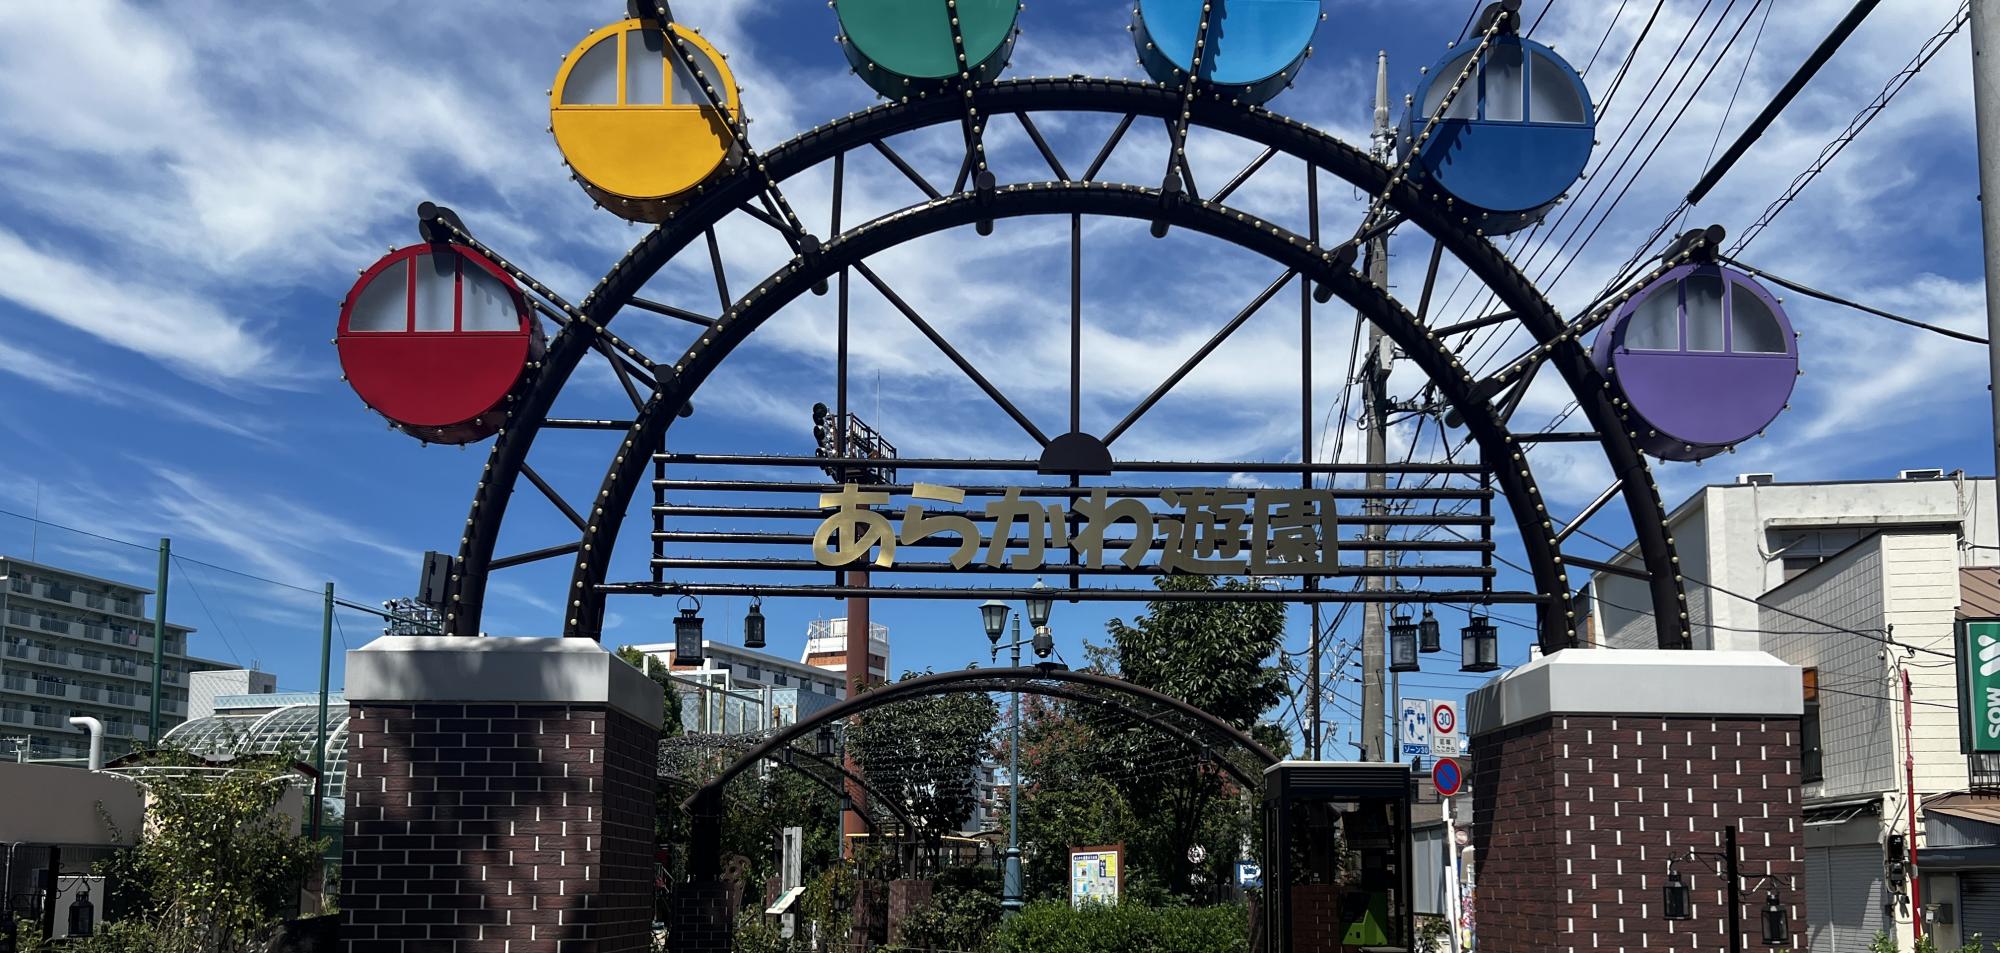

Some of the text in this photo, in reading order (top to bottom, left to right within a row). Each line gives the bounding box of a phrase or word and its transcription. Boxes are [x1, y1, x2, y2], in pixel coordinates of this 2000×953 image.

[812, 482, 1339, 575] あらかわ遊園
[1438, 712, 1451, 725] 30
[1404, 745, 1429, 754] ゾーン30
